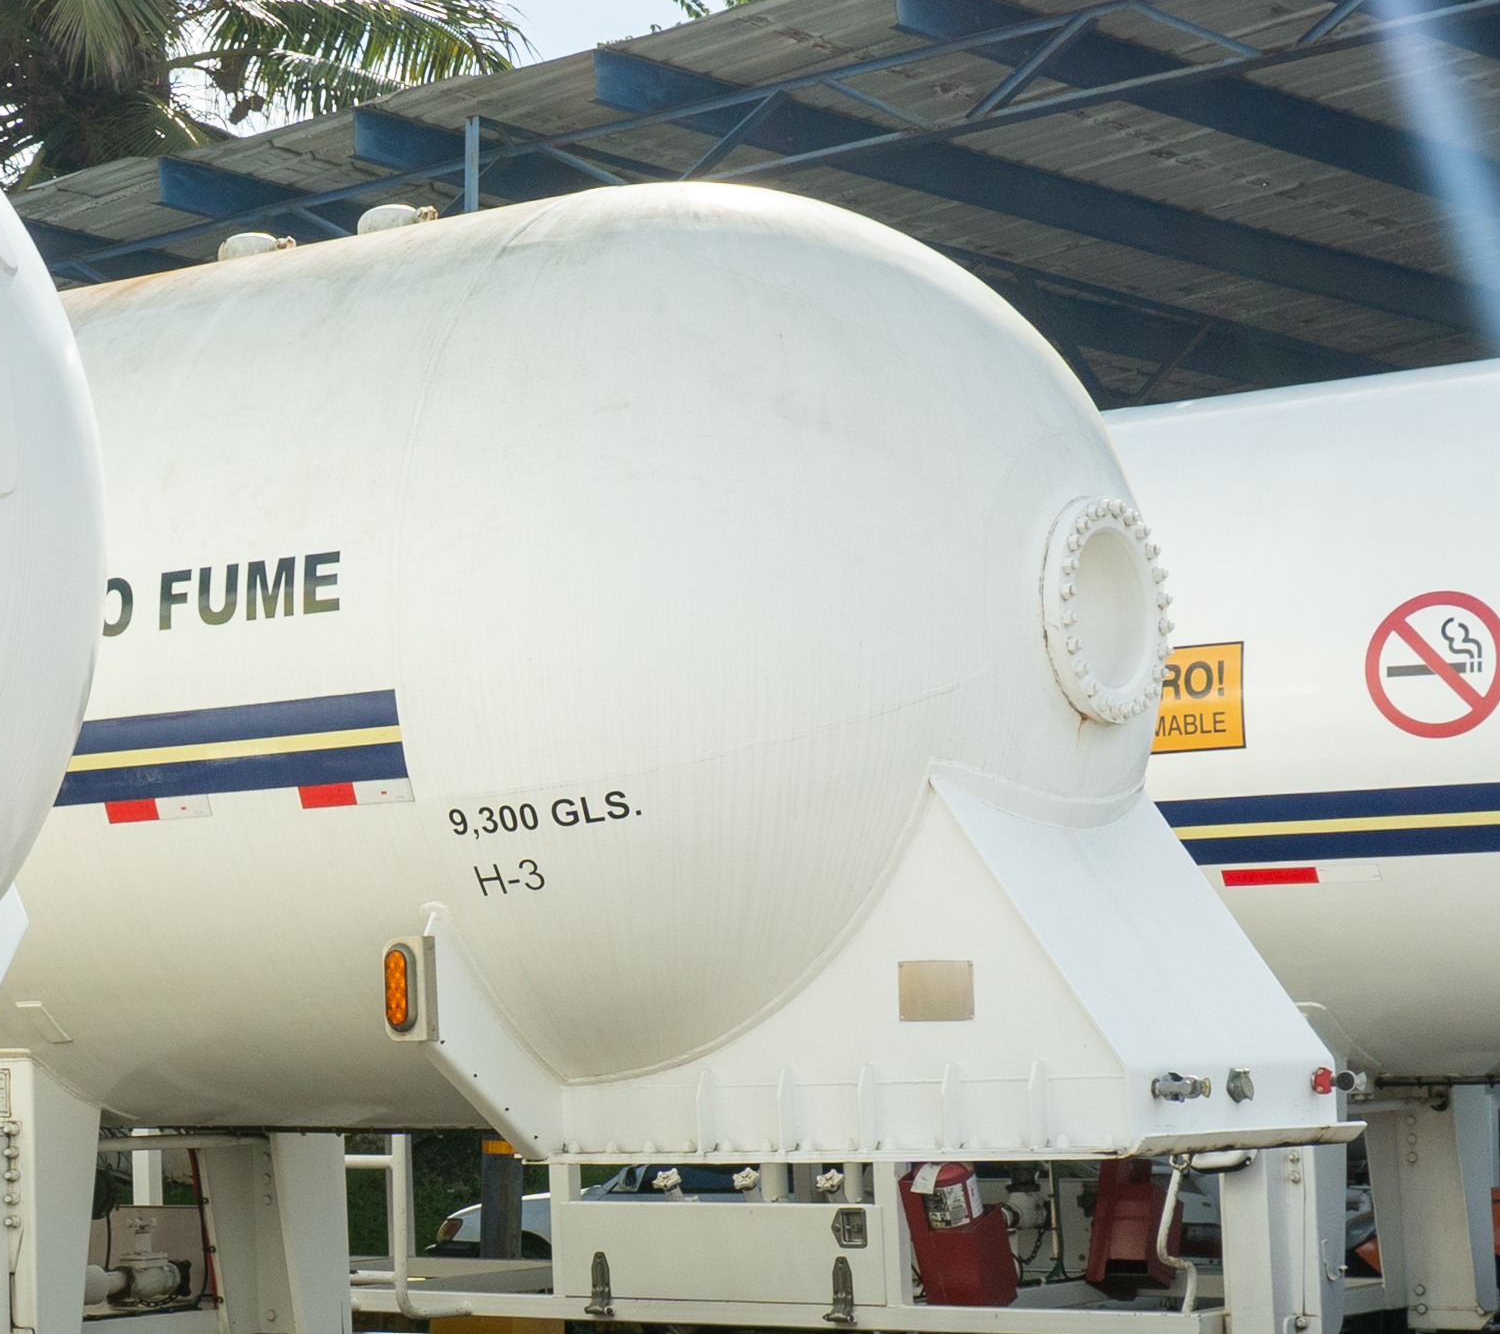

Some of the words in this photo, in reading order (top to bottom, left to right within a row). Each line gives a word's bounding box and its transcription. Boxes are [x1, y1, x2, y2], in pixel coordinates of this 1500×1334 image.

[102, 577, 134, 638] O
[158, 550, 341, 631] FUME
[448, 803, 539, 840] 9,300
[551, 790, 642, 827] GLS.
[473, 859, 545, 897] H-3
